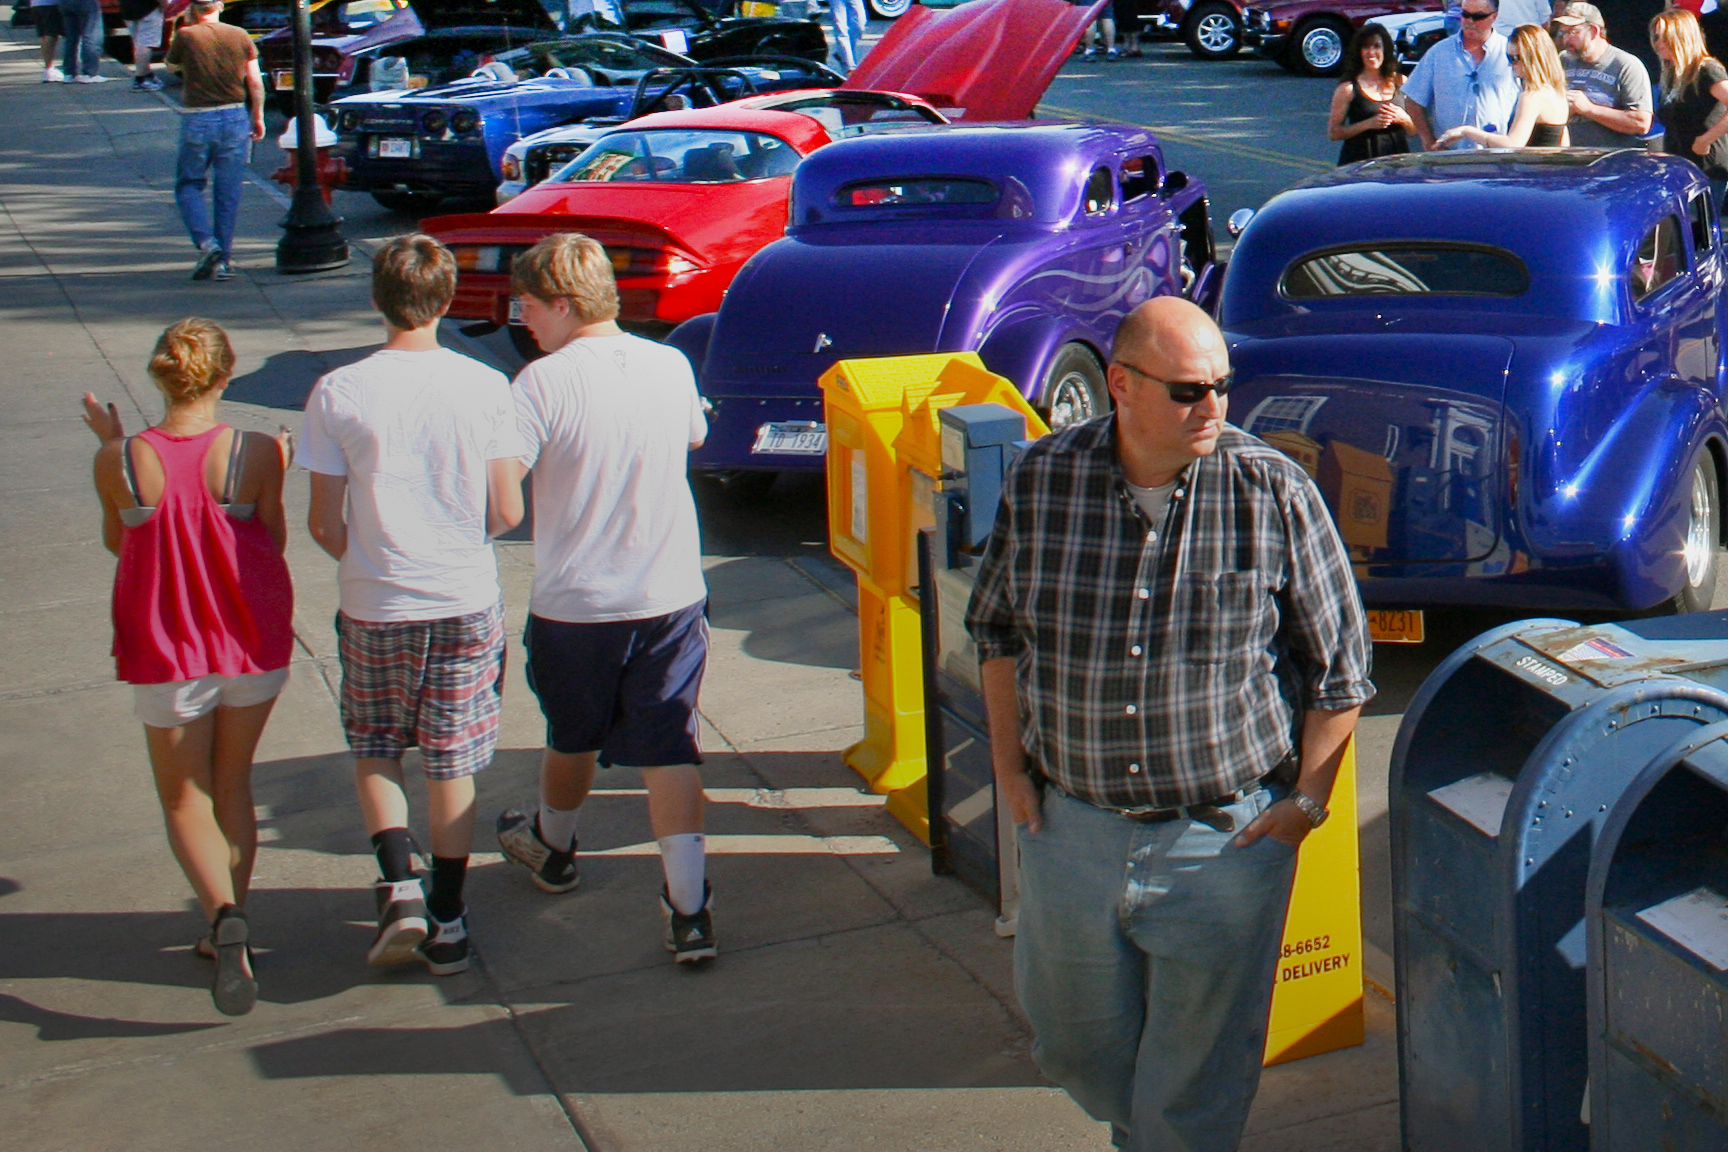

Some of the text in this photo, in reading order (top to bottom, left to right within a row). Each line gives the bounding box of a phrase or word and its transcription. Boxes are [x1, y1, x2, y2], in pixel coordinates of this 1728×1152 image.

[791, 432, 823, 449] 1934
[1516, 656, 1569, 686] STAMPED
[1280, 934, 1331, 959] 8-6652
[1282, 952, 1351, 983] DELIVERY
